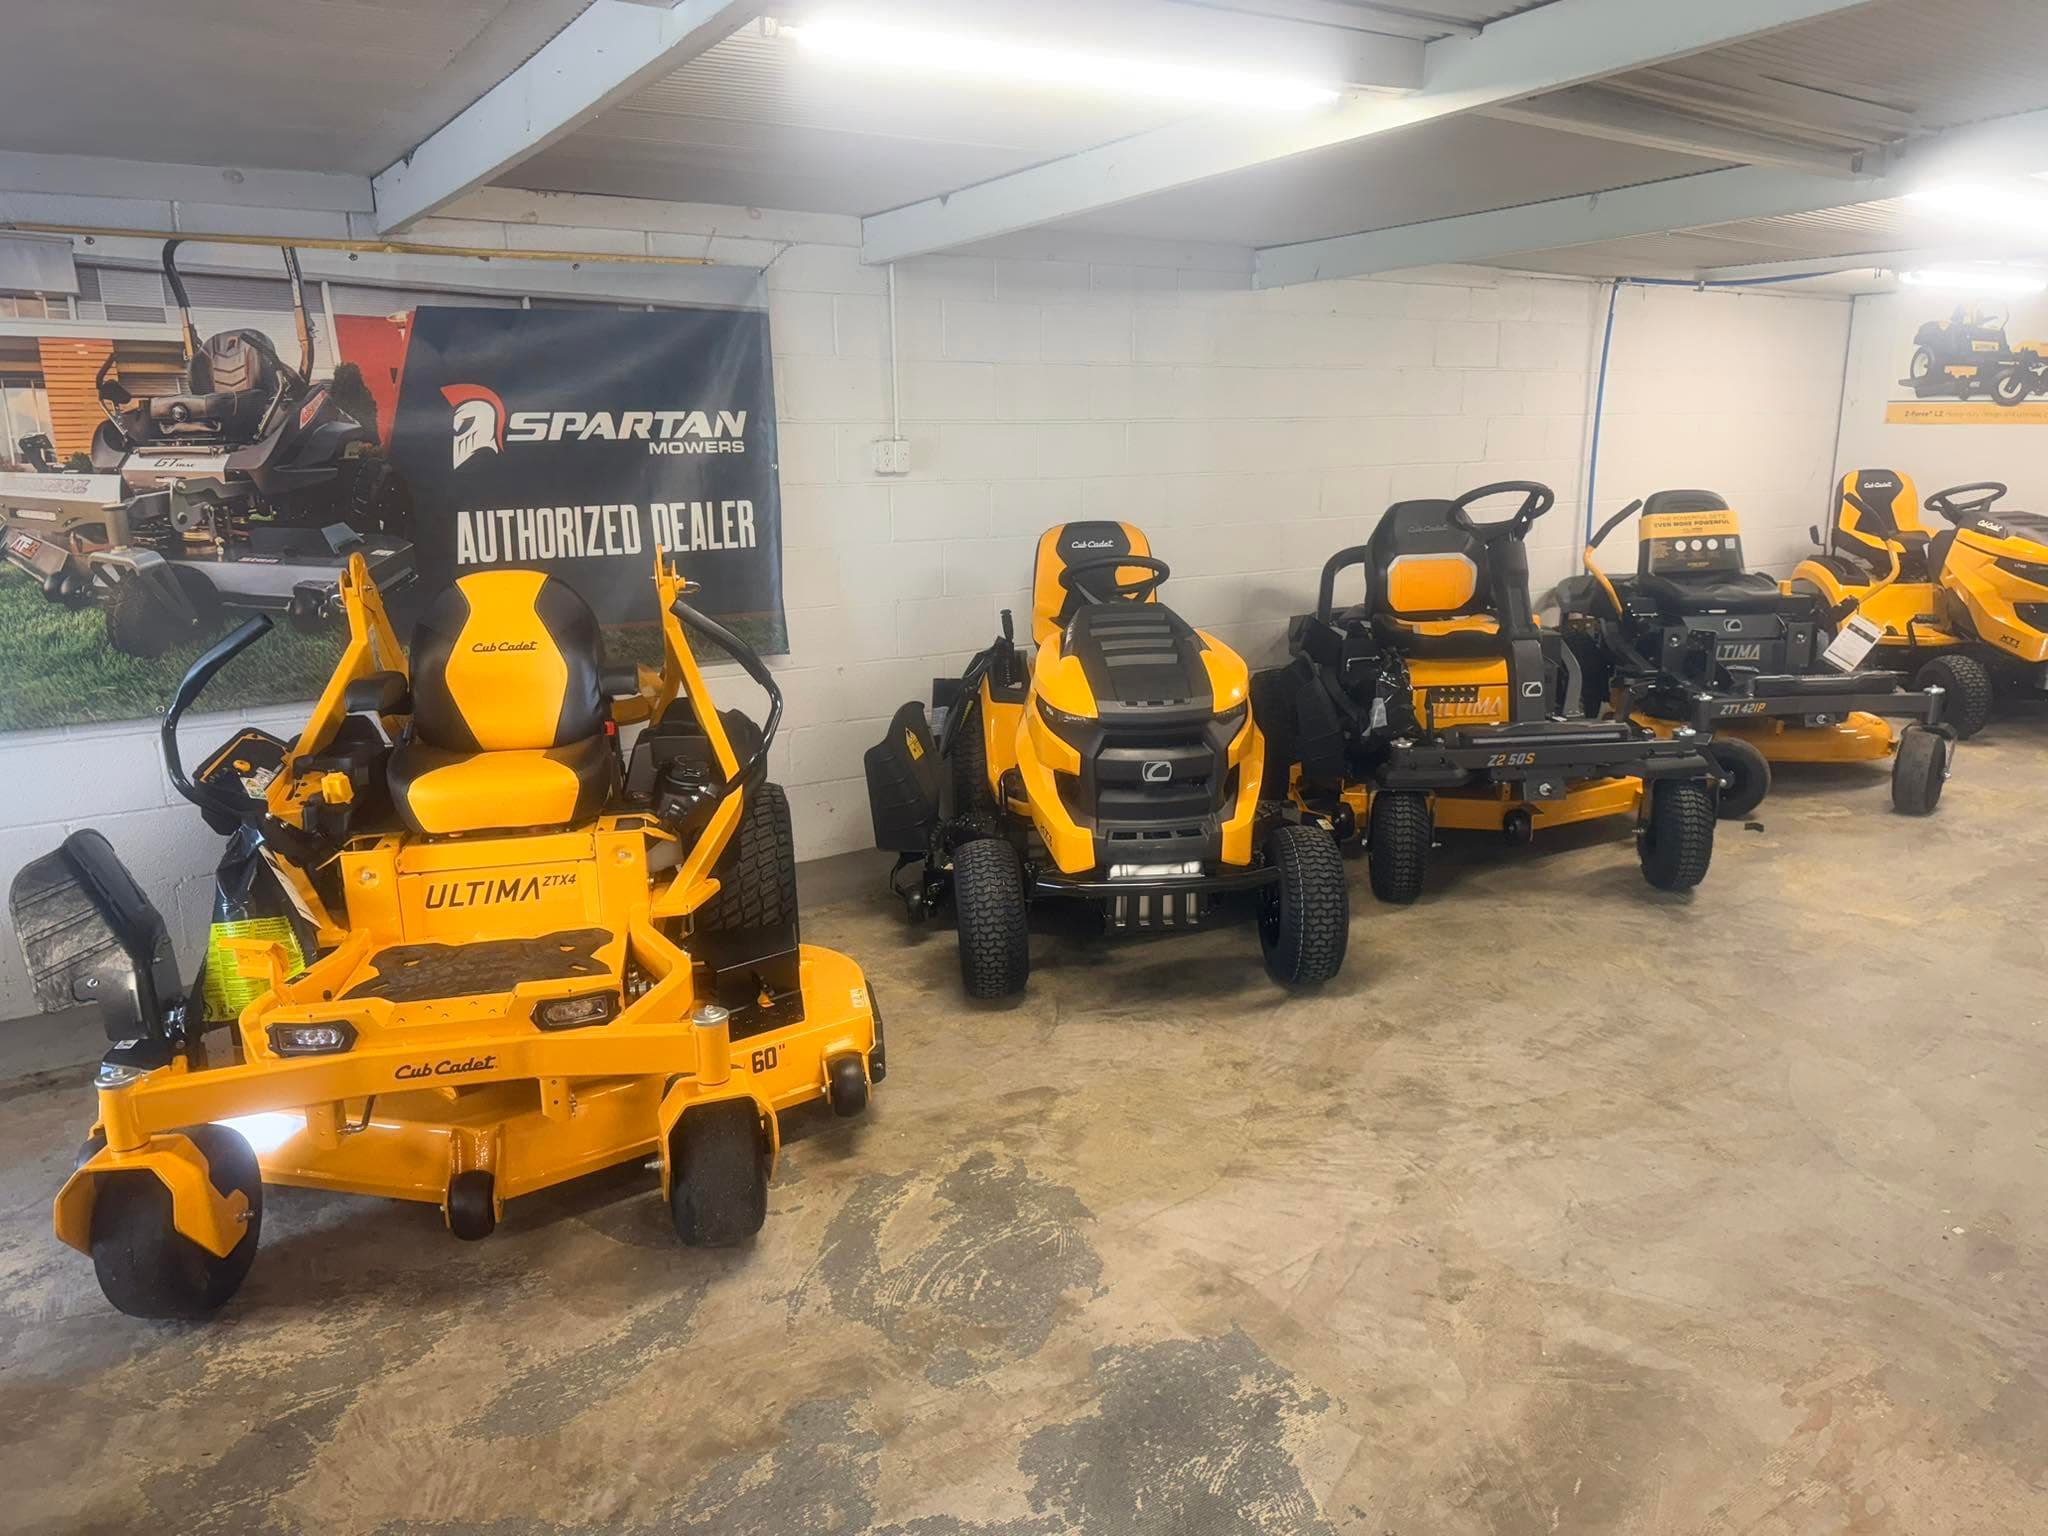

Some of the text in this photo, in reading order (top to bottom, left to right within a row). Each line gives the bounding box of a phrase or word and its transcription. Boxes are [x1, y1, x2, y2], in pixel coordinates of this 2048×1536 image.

[507, 410, 747, 441] SPARTAN
[648, 440, 745, 455] MOWERS
[456, 499, 757, 565] AUTHORIZED DEALER
[1071, 539, 1115, 549] Cub Cadet
[472, 640, 538, 653] Cub Cadet
[1716, 643, 1761, 661] LTIMA
[1487, 751, 1536, 767] Z2 50S
[425, 873, 577, 909] ULTIMA ZTX4
[394, 1055, 497, 1080] Cub Cadet
